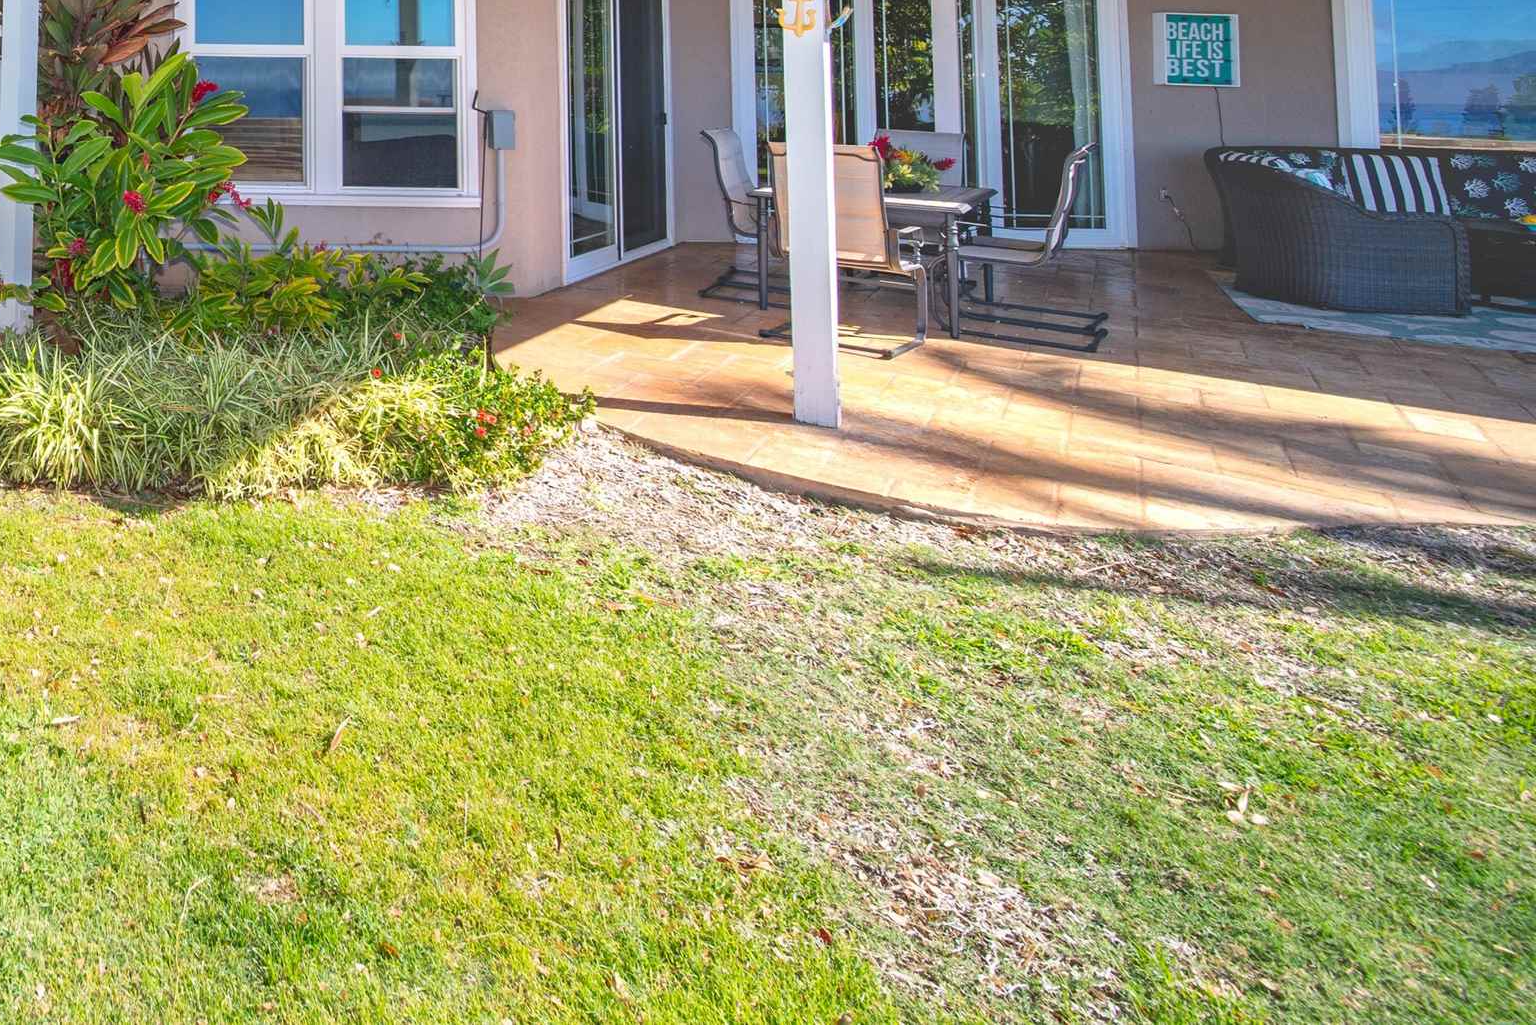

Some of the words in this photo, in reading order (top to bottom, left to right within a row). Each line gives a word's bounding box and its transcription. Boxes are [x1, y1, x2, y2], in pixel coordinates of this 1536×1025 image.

[1167, 21, 1224, 41] BEACH
[1167, 40, 1203, 59] LIFE
[1207, 41, 1224, 59] IS
[1167, 59, 1224, 78] BEST
